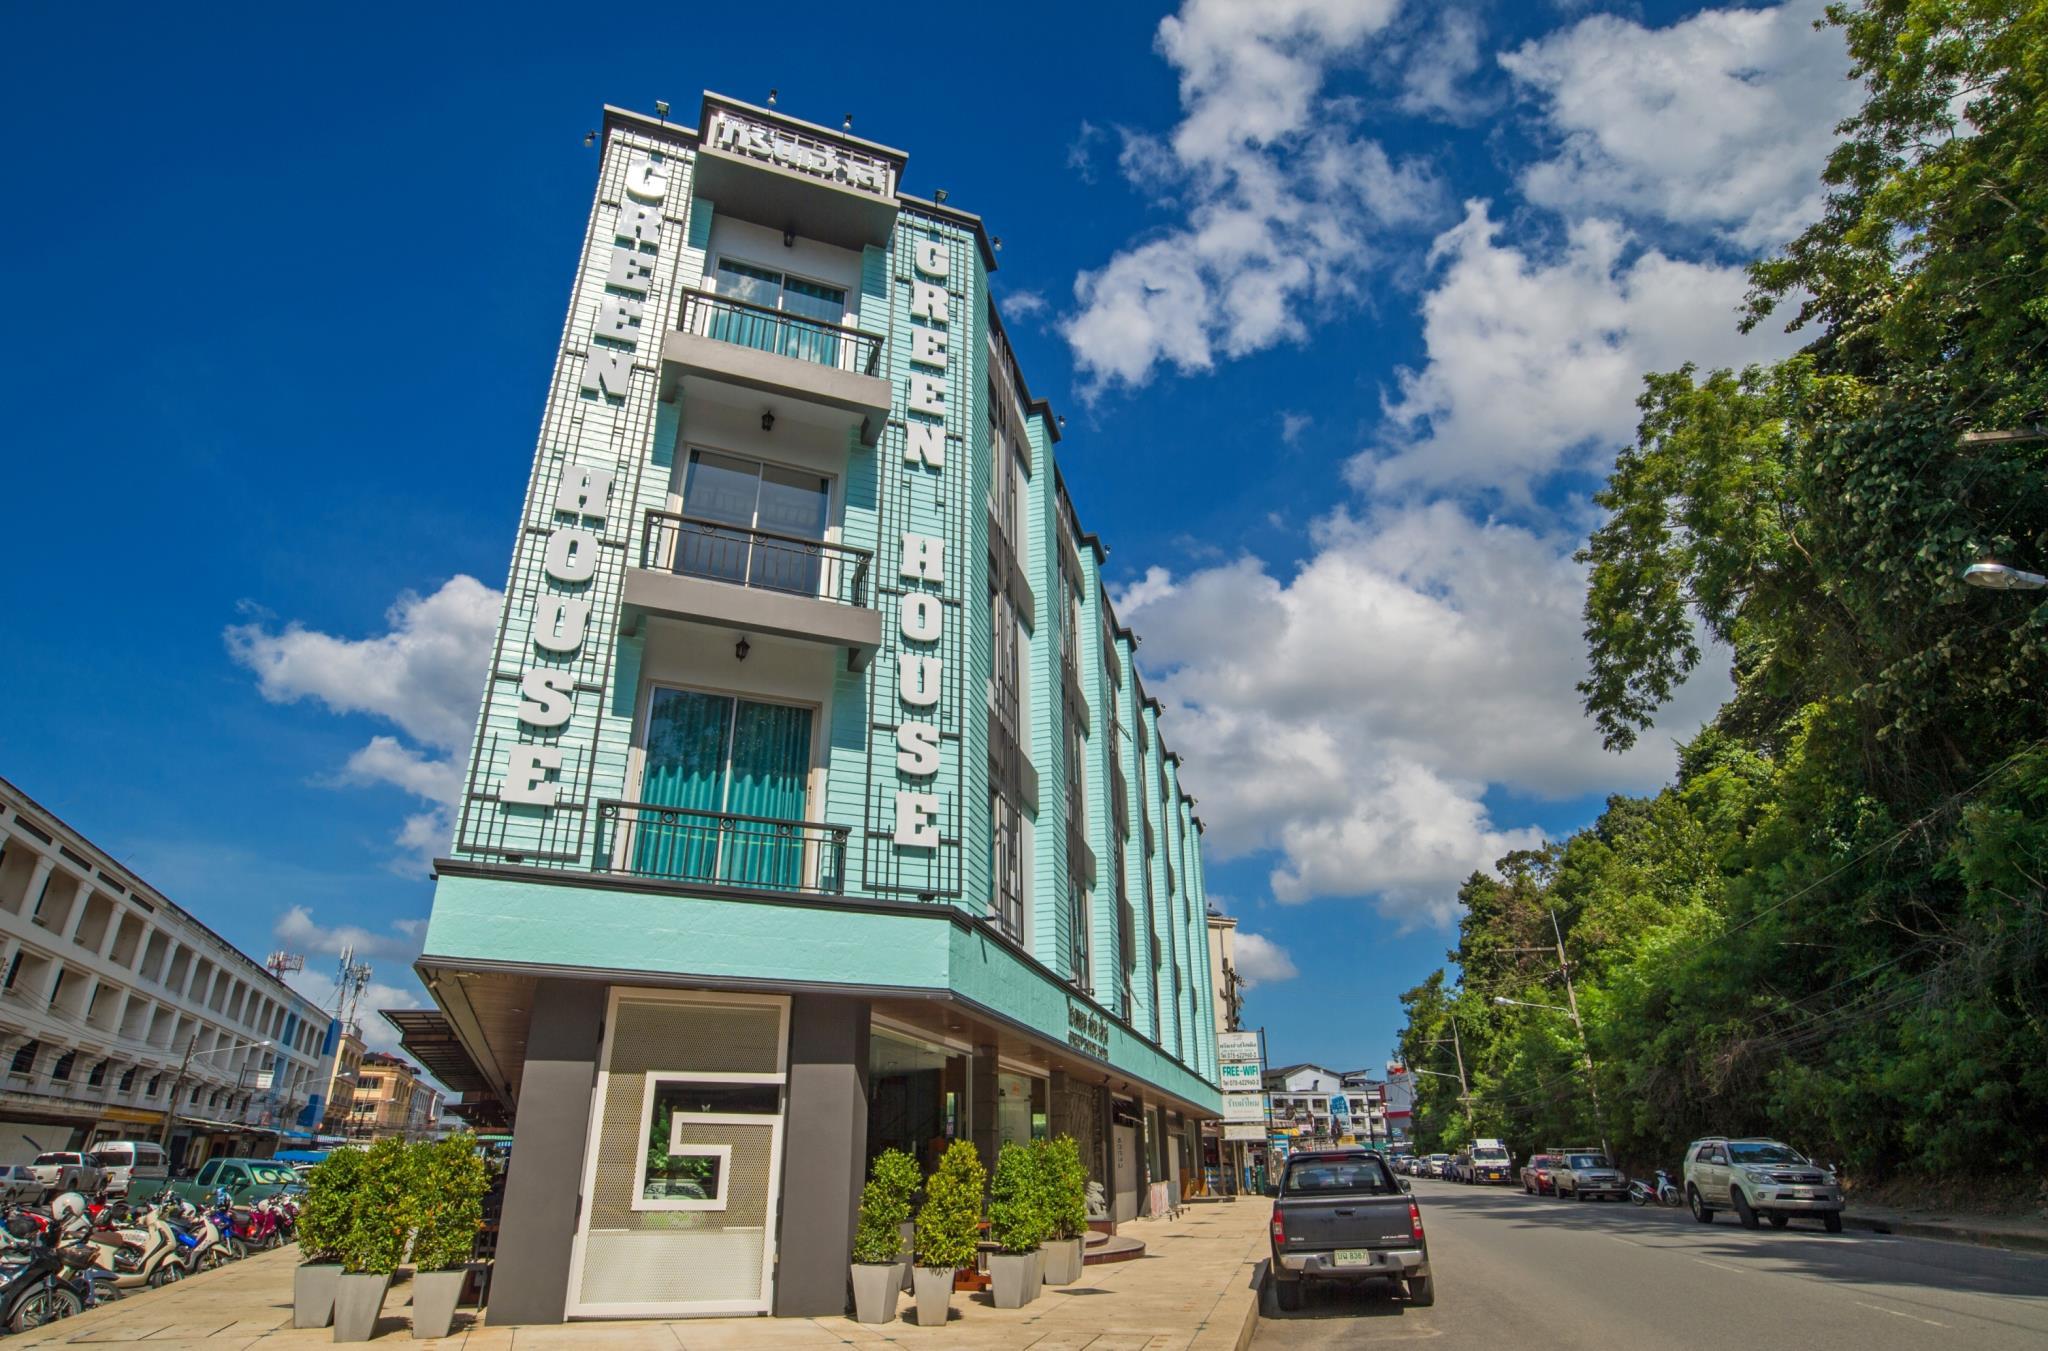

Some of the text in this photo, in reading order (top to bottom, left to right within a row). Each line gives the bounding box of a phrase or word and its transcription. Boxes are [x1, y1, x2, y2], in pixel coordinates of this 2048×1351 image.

[499, 158, 669, 806] GREEN HOUSE
[893, 239, 950, 848] GREEN HOUSE
[1222, 1065, 1259, 1076] FREE-WIFI
